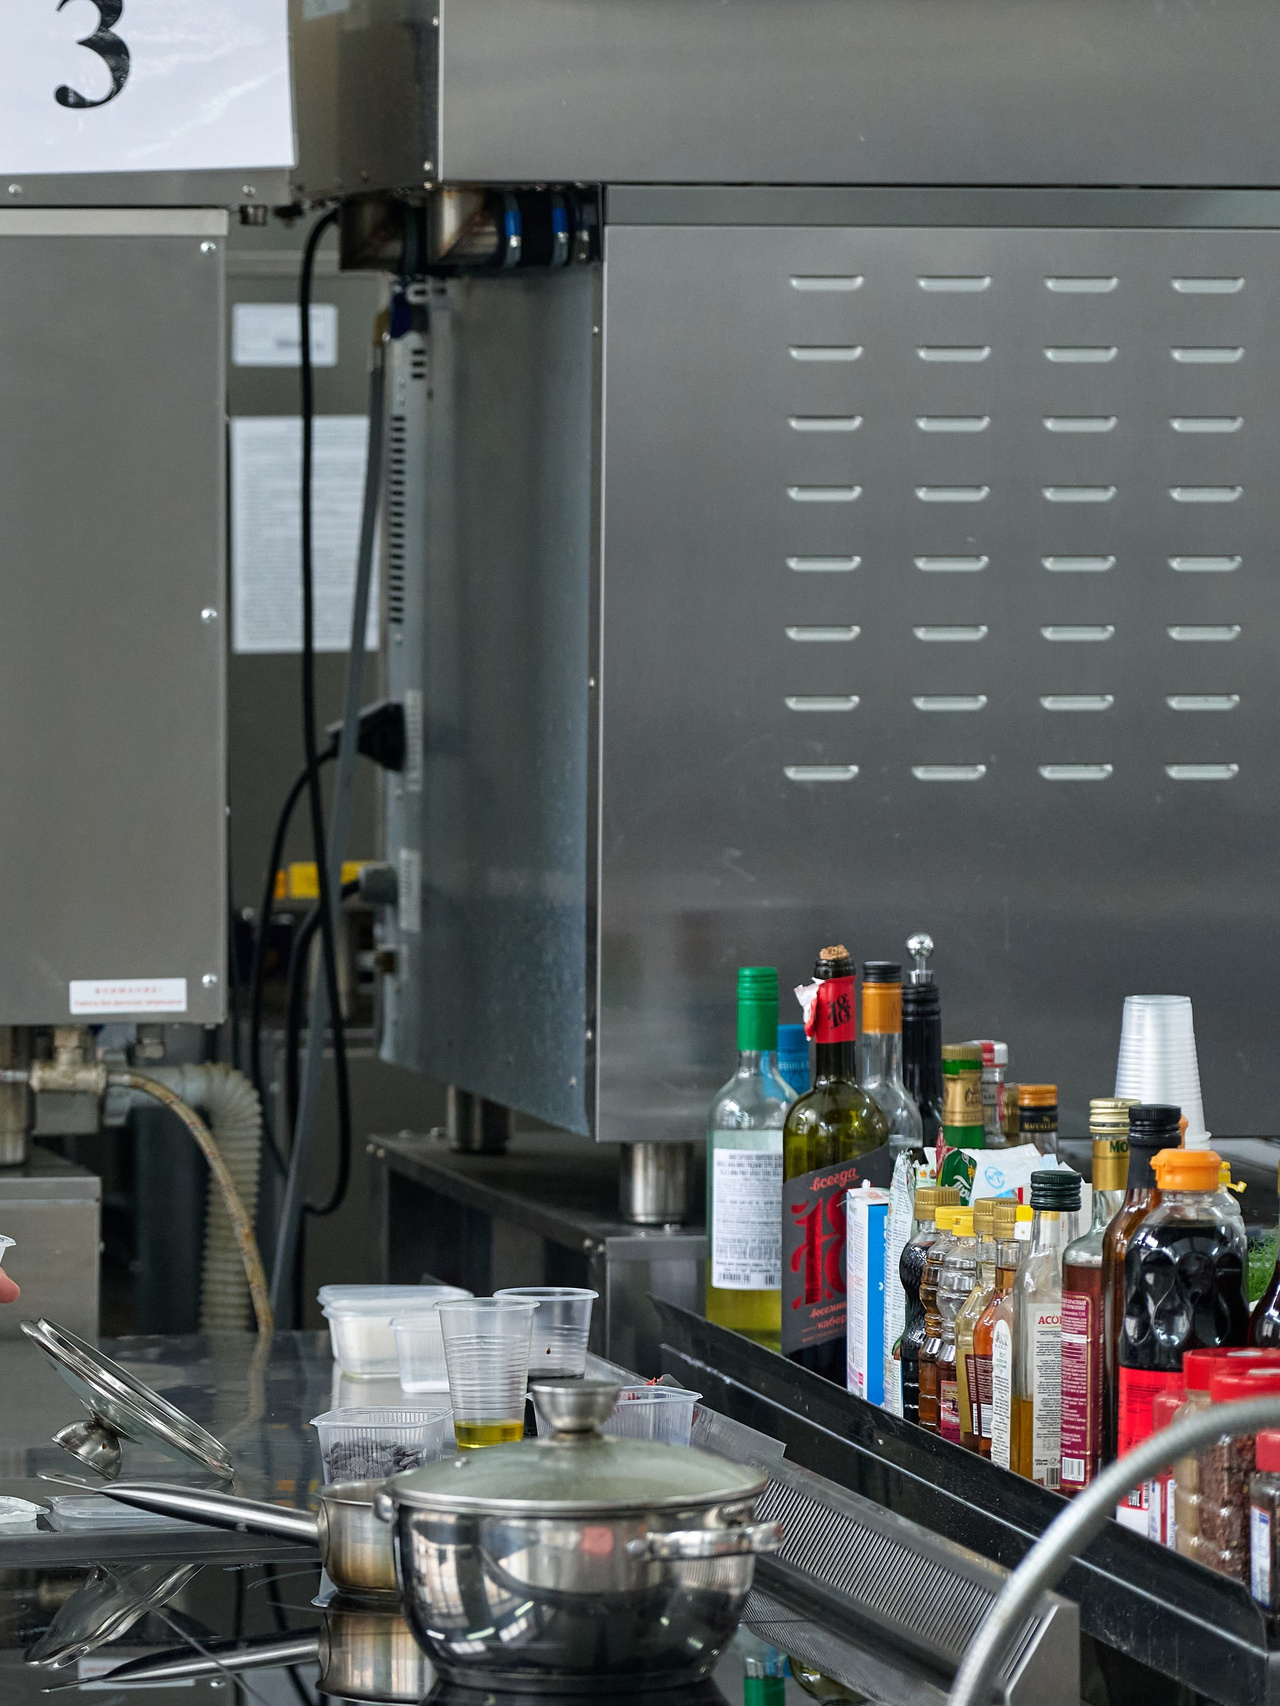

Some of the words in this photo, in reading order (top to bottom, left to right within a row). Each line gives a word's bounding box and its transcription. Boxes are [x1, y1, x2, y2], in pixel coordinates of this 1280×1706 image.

[53, 0, 132, 109] 3
[826, 993, 853, 1030] 18
[809, 1167, 860, 1192] всегда
